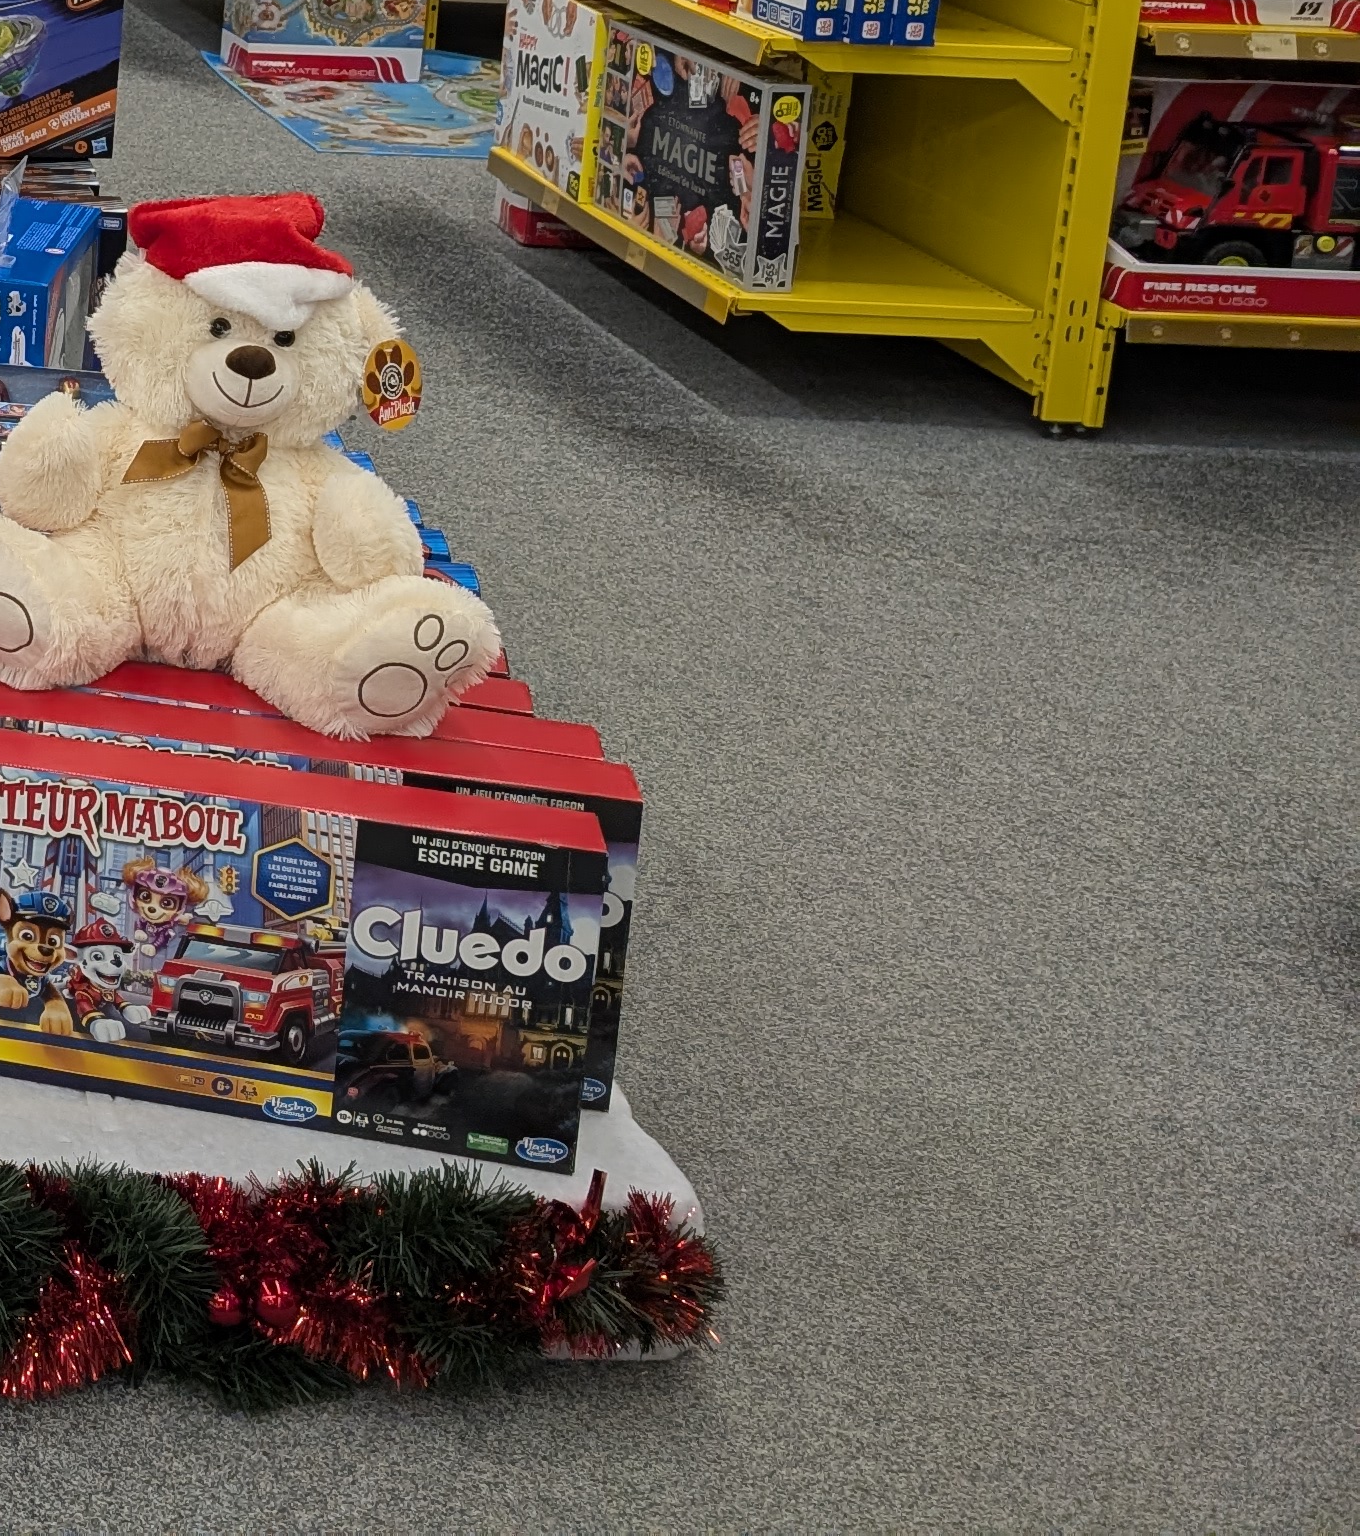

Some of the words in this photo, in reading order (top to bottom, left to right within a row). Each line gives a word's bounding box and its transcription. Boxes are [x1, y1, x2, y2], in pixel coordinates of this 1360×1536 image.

[652, 127, 718, 184] MAGIE
[1142, 281, 1177, 295] FIRE
[1180, 282, 1257, 296] RESCUE
[1142, 293, 1216, 307] UNIMOG
[102, 788, 243, 848] MABOUL
[412, 834, 426, 846] UN
[429, 837, 448, 848] JEU
[452, 839, 508, 858] D'ENQUÊTE
[509, 848, 546, 863] FAÇON
[417, 848, 485, 871] ESCAPE
[489, 858, 539, 879] GAME
[353, 906, 587, 983] Cluedo
[396, 981, 465, 1001] MANOIR
[473, 992, 533, 1010] TUDOR
[403, 970, 496, 991] TRAHISON
[504, 985, 527, 996] AU
[522, 1138, 564, 1156] Hasbro
